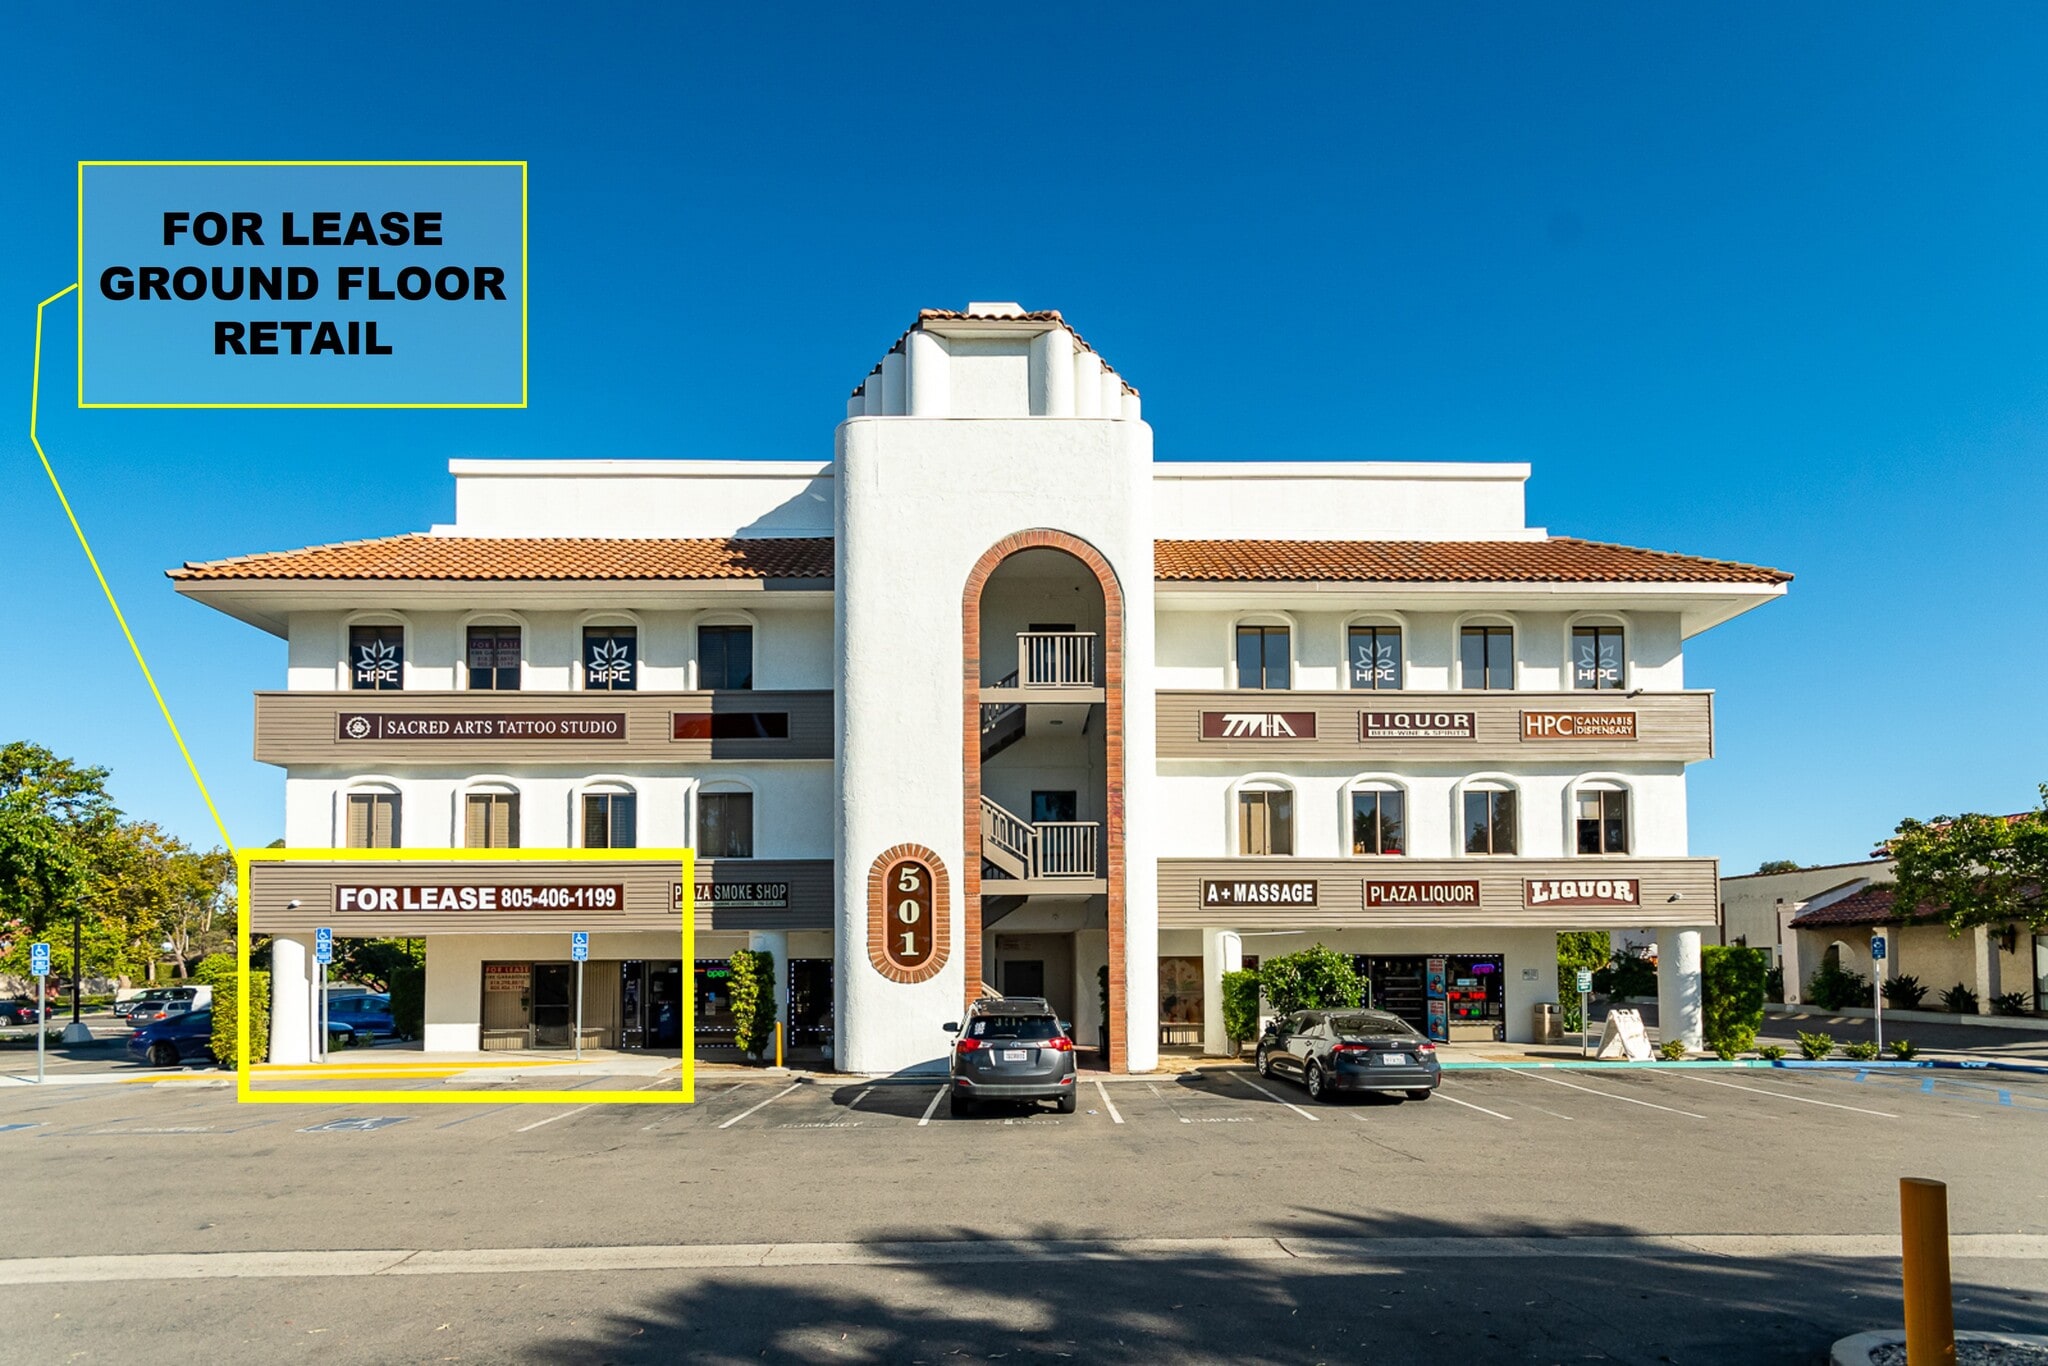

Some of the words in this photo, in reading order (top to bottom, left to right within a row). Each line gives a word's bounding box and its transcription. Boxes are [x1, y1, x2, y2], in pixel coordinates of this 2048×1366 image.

[357, 670, 398, 682] HPC
[590, 670, 631, 682] HPC
[1356, 669, 1395, 681] HPC
[1578, 669, 1618, 680] HPC
[387, 720, 450, 735] SACRED
[453, 720, 493, 735] ARTS
[497, 720, 557, 735] TATTOO
[560, 720, 617, 735] STUDIO
[1367, 714, 1469, 729] LIQUOR
[1526, 715, 1573, 735] HPC
[1576, 716, 1633, 725] CANNABIS
[1576, 726, 1633, 735] DISPENSARY
[340, 888, 399, 910] FOR
[402, 887, 497, 910] LEASE
[501, 888, 616, 908] 805-406-1199
[675, 885, 711, 900] PZA
[714, 884, 753, 900] SMOKE
[756, 884, 787, 900] SHOP
[1234, 884, 1313, 902] MASSAGE
[1370, 885, 1417, 902] PLAZA
[1421, 885, 1474, 903] LIQUOR
[1531, 881, 1634, 903] LIQUOR
